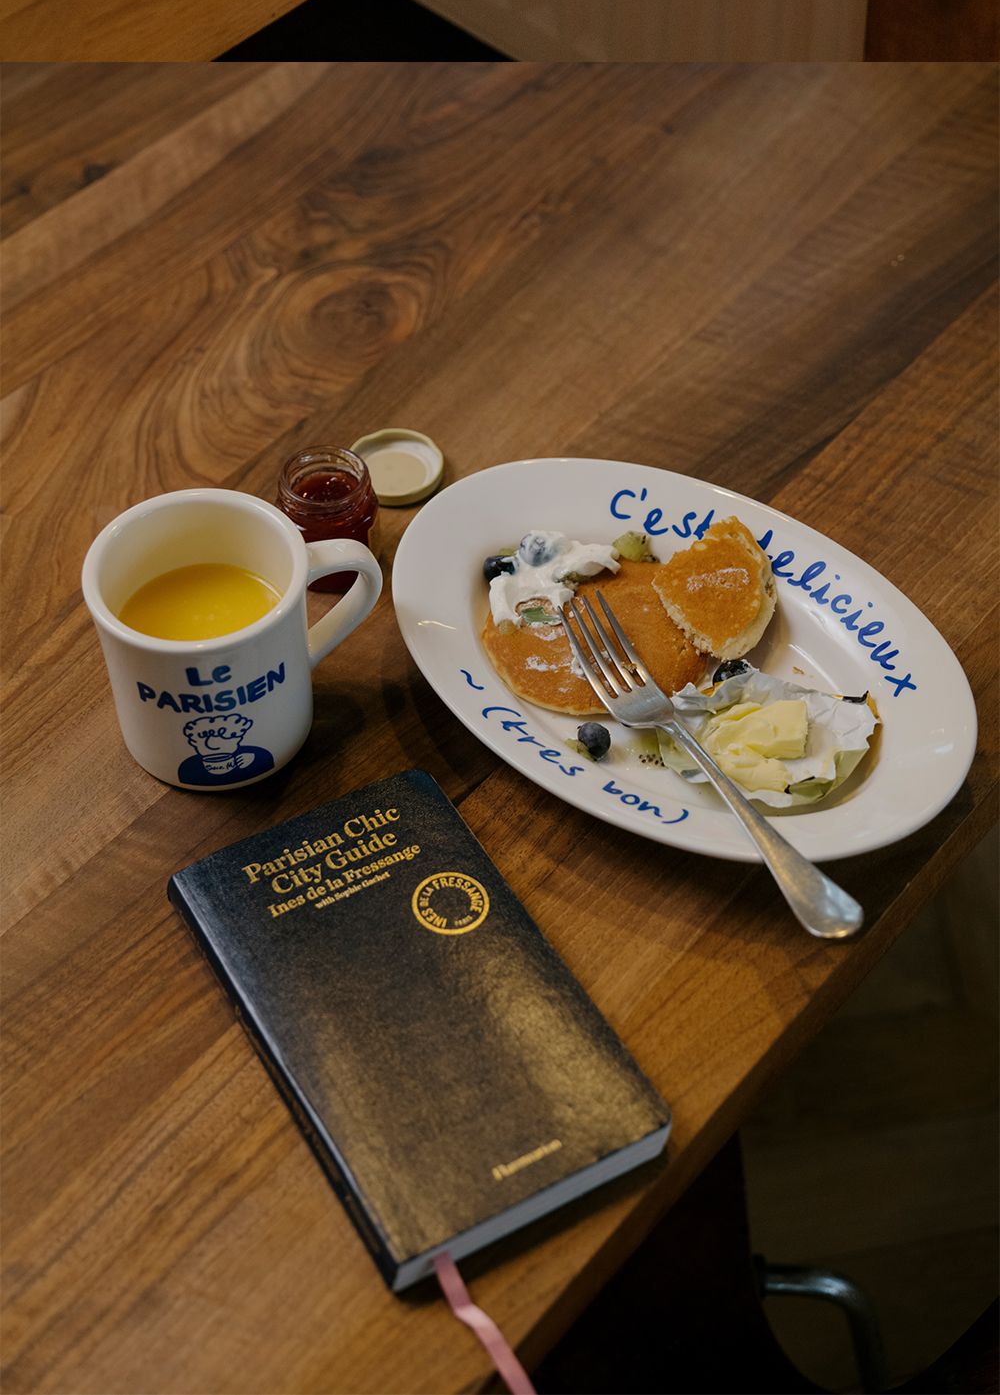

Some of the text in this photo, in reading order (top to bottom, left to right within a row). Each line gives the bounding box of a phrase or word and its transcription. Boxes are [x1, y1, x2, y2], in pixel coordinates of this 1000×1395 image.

[609, 488, 716, 540] C'est
[136, 662, 285, 714] PARISIEN
[481, 706, 690, 824] (tres bon)
[241, 808, 400, 885] Parisian Chic
[271, 832, 398, 894] City Guide
[267, 844, 421, 918] Ines de la Fressange
[421, 886, 434, 897] LA
[431, 877, 483, 913] FRESSANGE
[421, 907, 448, 929] INES
